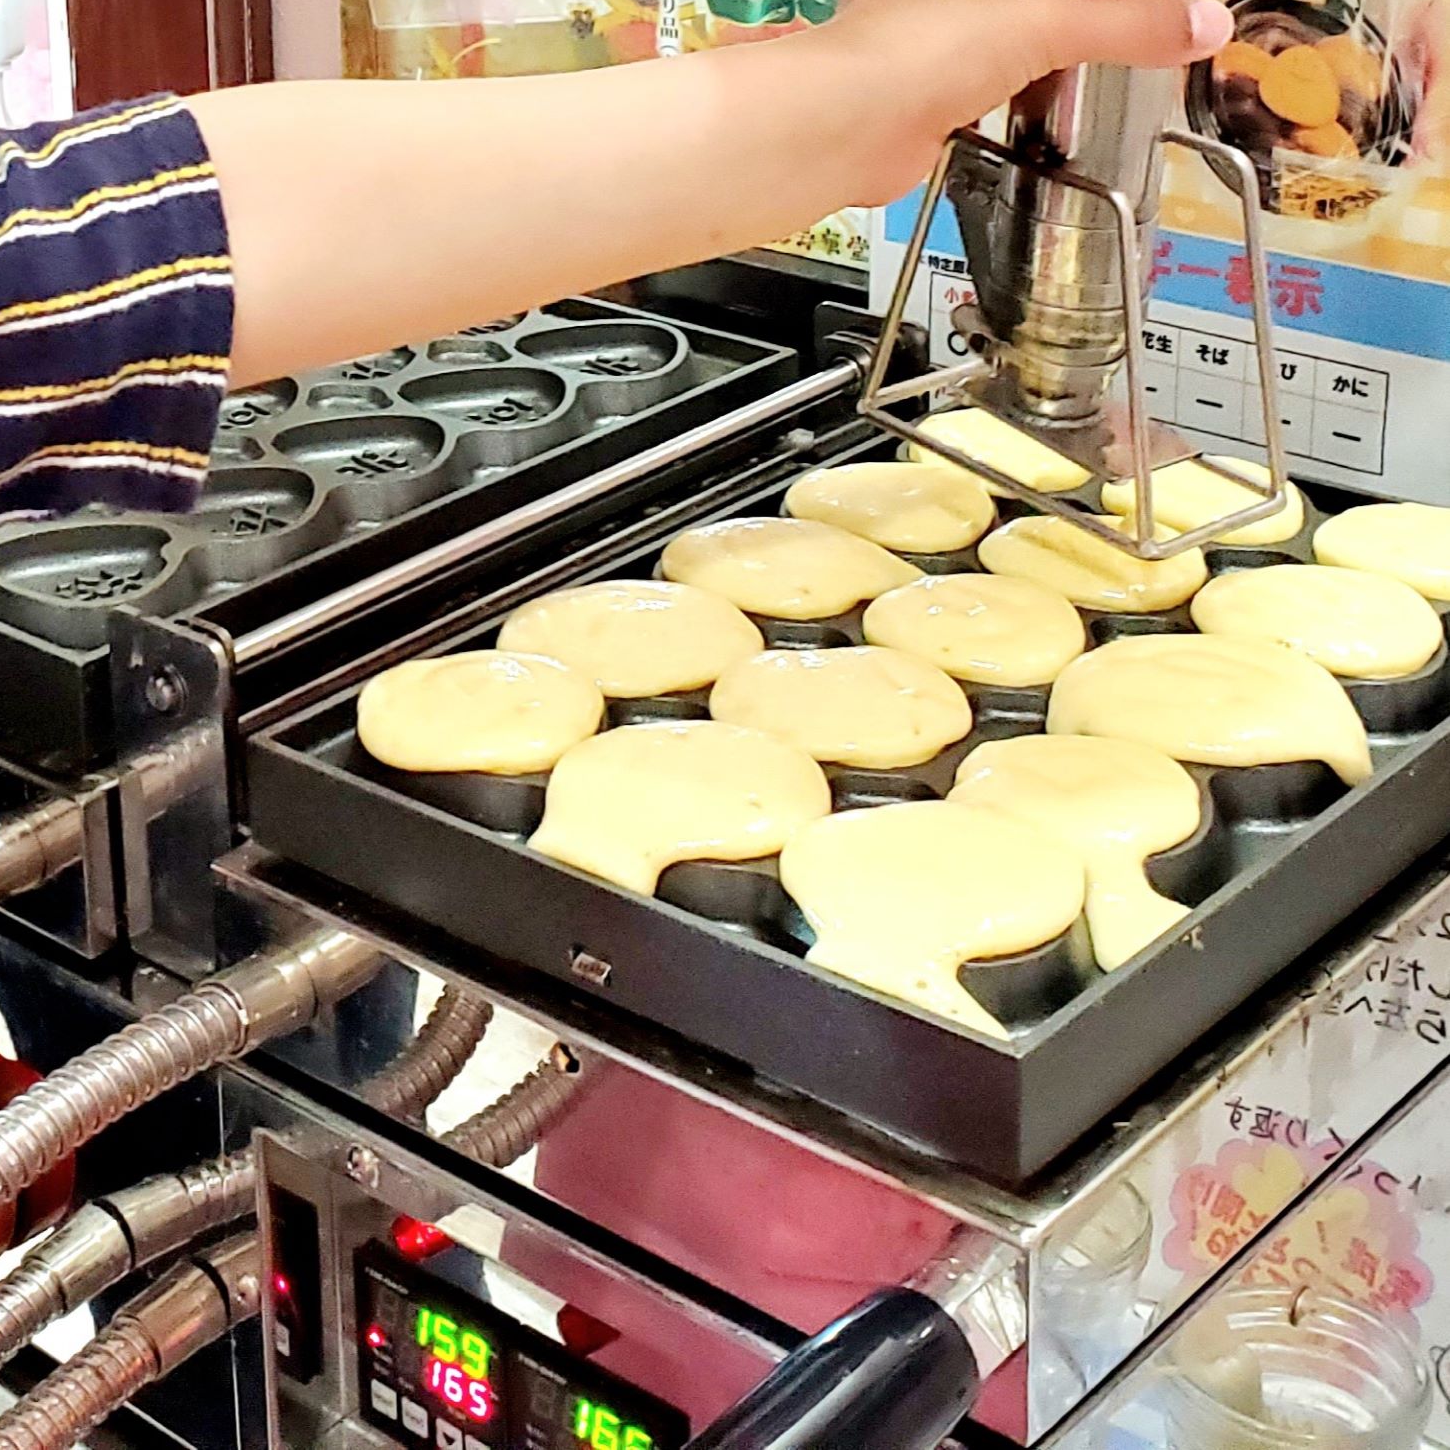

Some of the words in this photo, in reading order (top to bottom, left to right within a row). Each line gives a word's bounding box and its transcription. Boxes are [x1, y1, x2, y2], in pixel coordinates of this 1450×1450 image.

[1196, 344, 1230, 366] そば
[1333, 375, 1369, 398] かに
[417, 1307, 490, 1380] 159
[431, 1360, 488, 1418] 165
